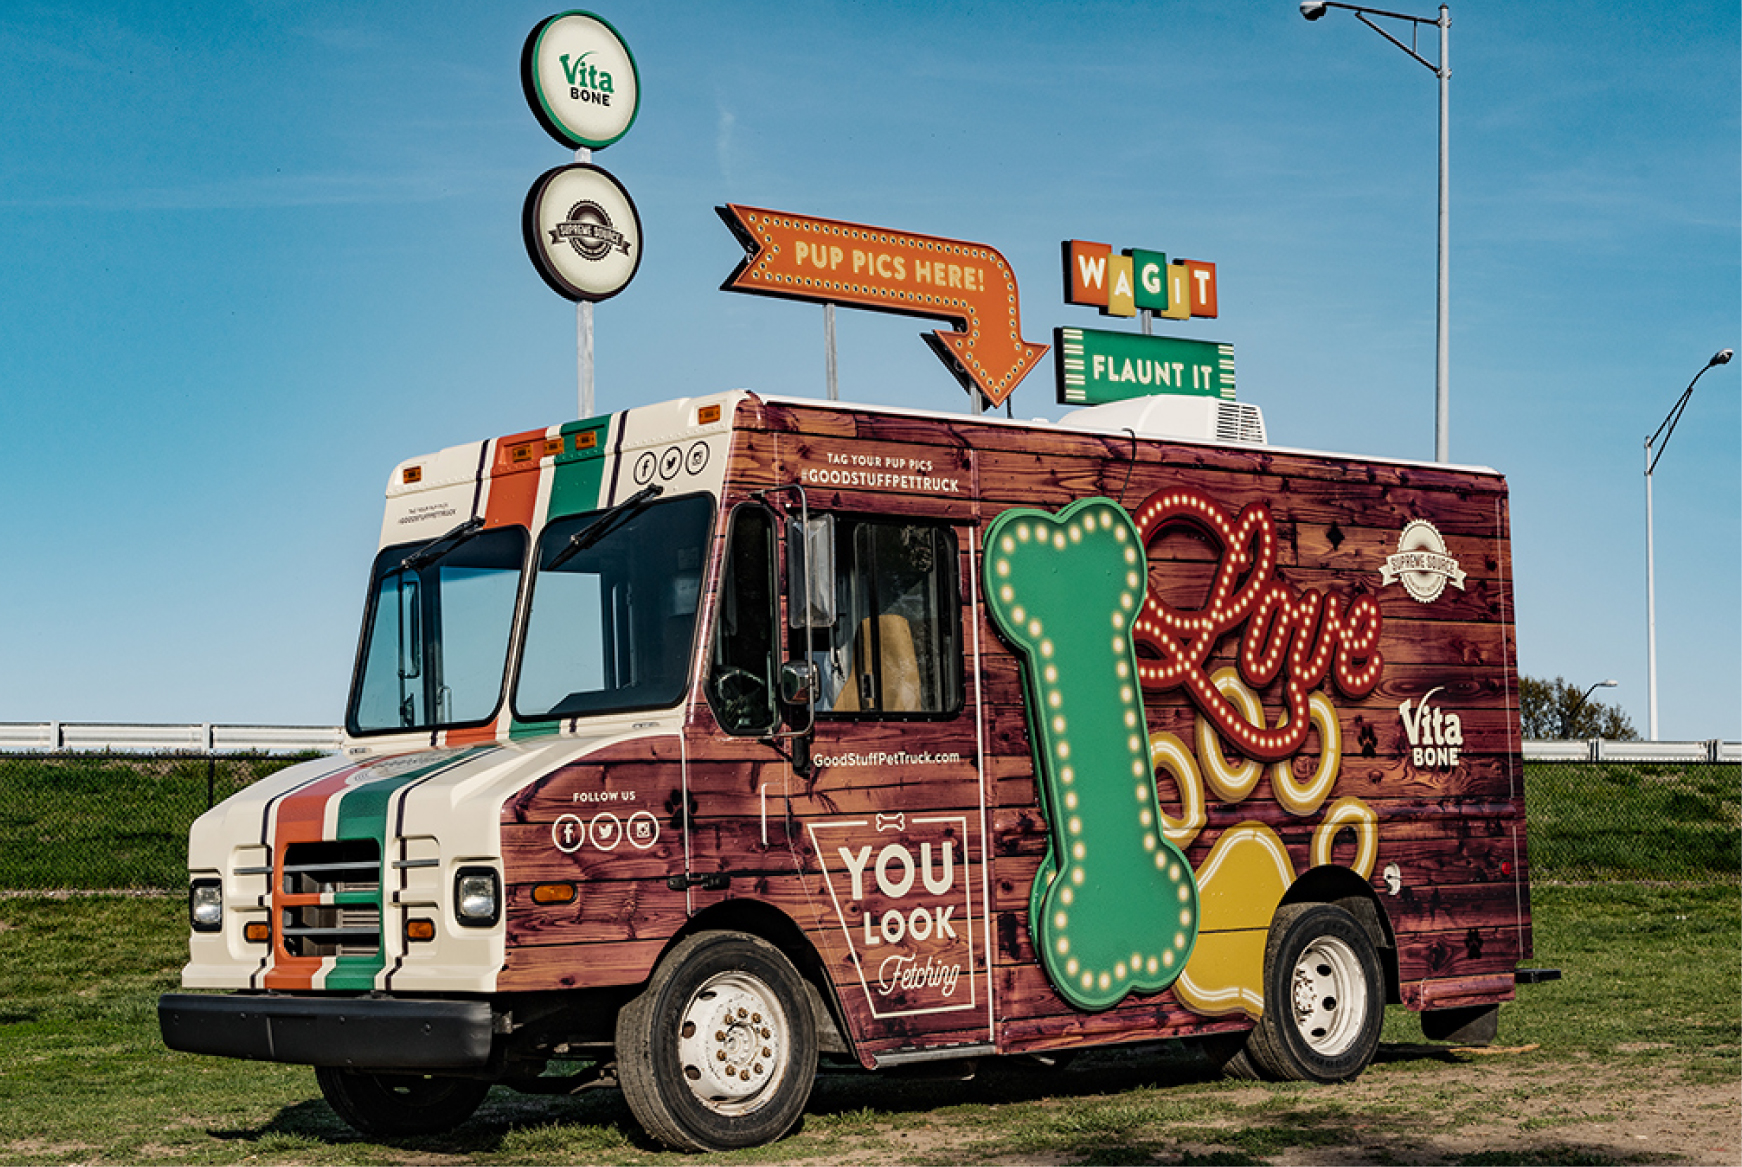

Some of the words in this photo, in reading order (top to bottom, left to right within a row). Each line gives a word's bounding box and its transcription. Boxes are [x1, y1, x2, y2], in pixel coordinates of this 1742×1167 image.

[559, 51, 615, 94] Vita
[570, 86, 611, 107] BONE
[795, 240, 844, 271] PUP
[852, 250, 907, 281] PICS
[914, 259, 986, 292] HERE!
[1092, 354, 1184, 387] FLAUNT
[1193, 364, 1213, 390] IT
[827, 452, 848, 465] TAG
[851, 454, 882, 467] YOUR
[885, 456, 906, 469] PUP
[909, 458, 934, 472] PICS
[801, 468, 959, 493] #GOODSTUFFPETTRUCK
[1391, 553, 1425, 571] SUPREME
[1427, 555, 1455, 575] SOURCE
[1399, 686, 1464, 746] Vita
[813, 751, 960, 768] GoodStuffPetTruck.com
[1413, 747, 1461, 767] BONE
[573, 791, 619, 803] FOLLOW
[621, 790, 636, 801] US
[838, 842, 954, 901] YOU
[864, 905, 957, 945] LOOK
[878, 953, 961, 998] Fetching
